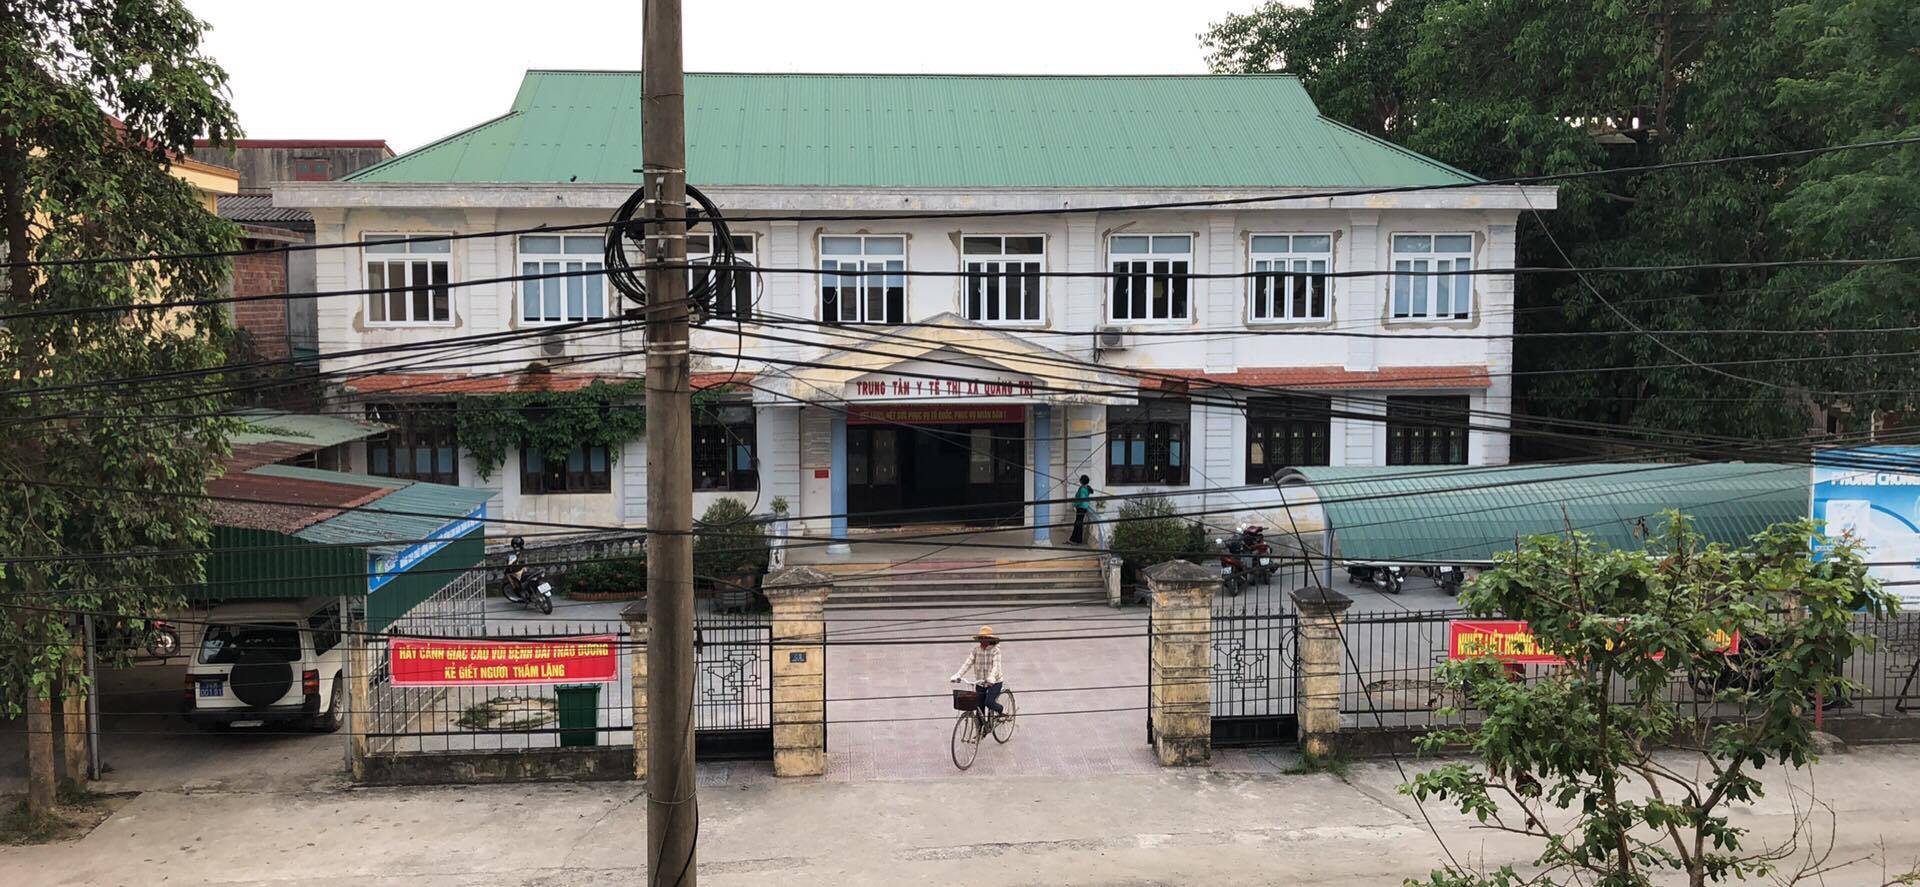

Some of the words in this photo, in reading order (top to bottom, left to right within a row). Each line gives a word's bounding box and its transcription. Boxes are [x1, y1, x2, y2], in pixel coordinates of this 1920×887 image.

[856, 381, 886, 396] TRUNG
[892, 378, 910, 396] TÂM
[916, 381, 922, 395] Y
[928, 377, 940, 396] TẾ
[946, 380, 961, 398] THỊ
[967, 377, 979, 395] XÃ
[984, 376, 1013, 397] QUẢNG
[1018, 380, 1034, 399] TRỊ
[399, 645, 416, 659] HÃY
[419, 643, 444, 659] CẢNH
[446, 645, 468, 660] GIÁC
[471, 647, 489, 660] CAO
[491, 646, 507, 660] VỚI
[509, 645, 533, 662] BỆNH
[535, 643, 550, 659] ĐÁI
[553, 645, 575, 657] THÁO
[578, 643, 608, 656] ĐƯỜNG
[444, 662, 456, 679] KẺ
[459, 663, 478, 679] GIẾT
[480, 664, 508, 679] NGƯỜI
[513, 663, 539, 678] THẦM
[541, 663, 565, 680] LẶNG
